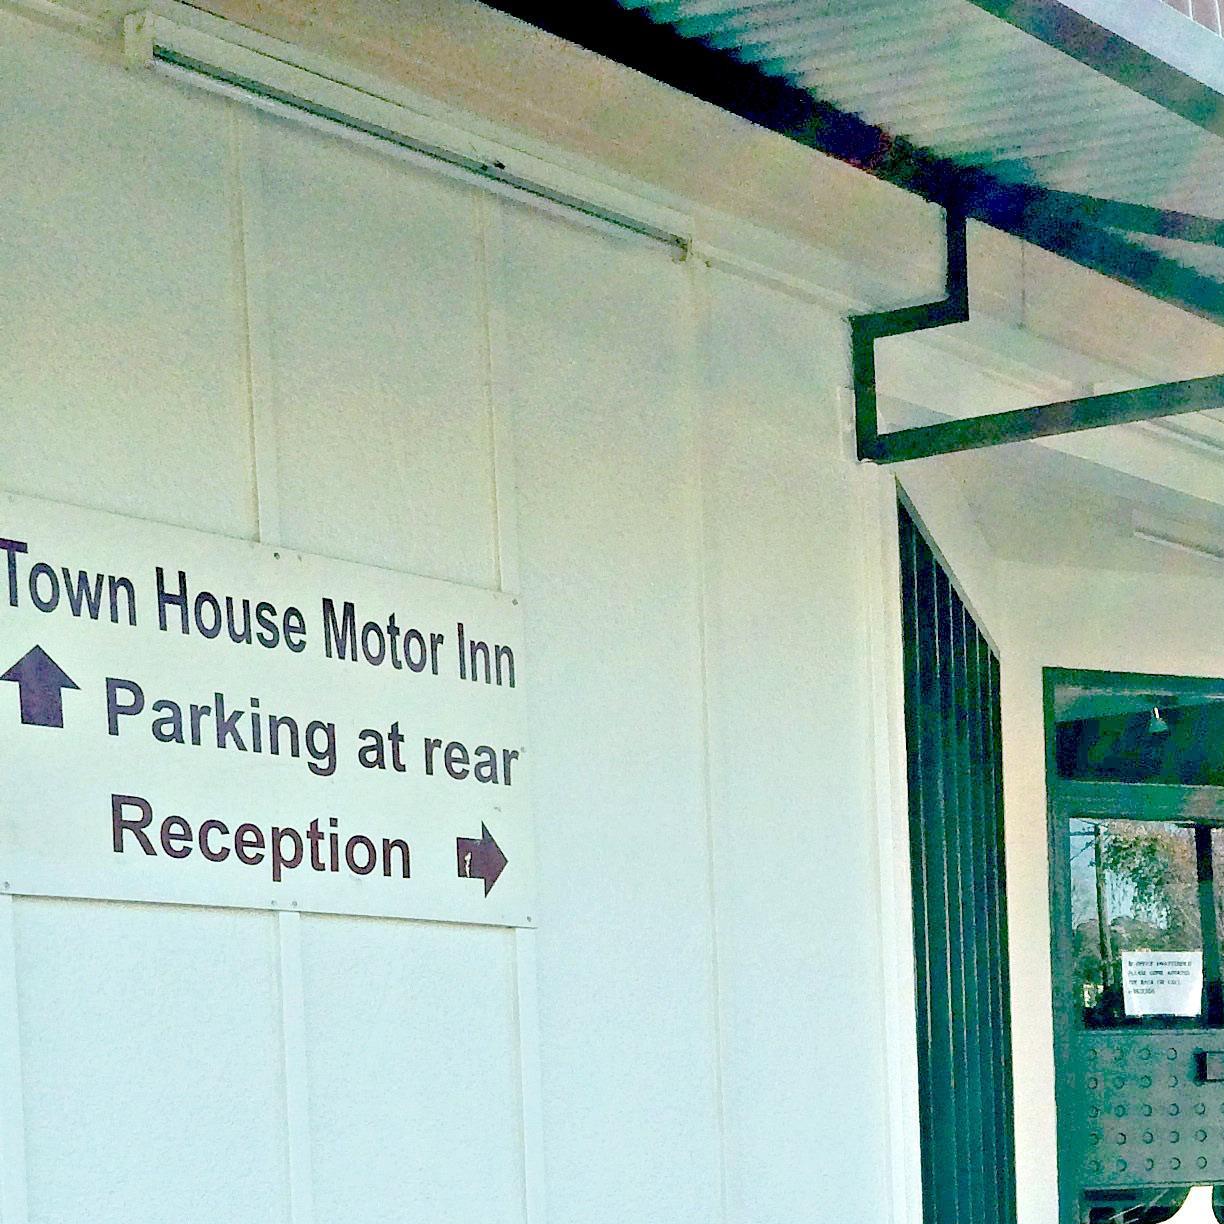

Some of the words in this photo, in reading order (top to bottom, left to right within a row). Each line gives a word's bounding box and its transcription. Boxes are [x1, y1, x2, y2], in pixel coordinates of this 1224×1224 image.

[0, 537, 137, 626] Town
[156, 566, 307, 653] House
[322, 597, 444, 676] Motor
[457, 622, 516, 688] Inn
[105, 676, 337, 777] Parking
[358, 721, 407, 773] at
[424, 736, 519, 787] rear
[110, 793, 412, 882] Reception
